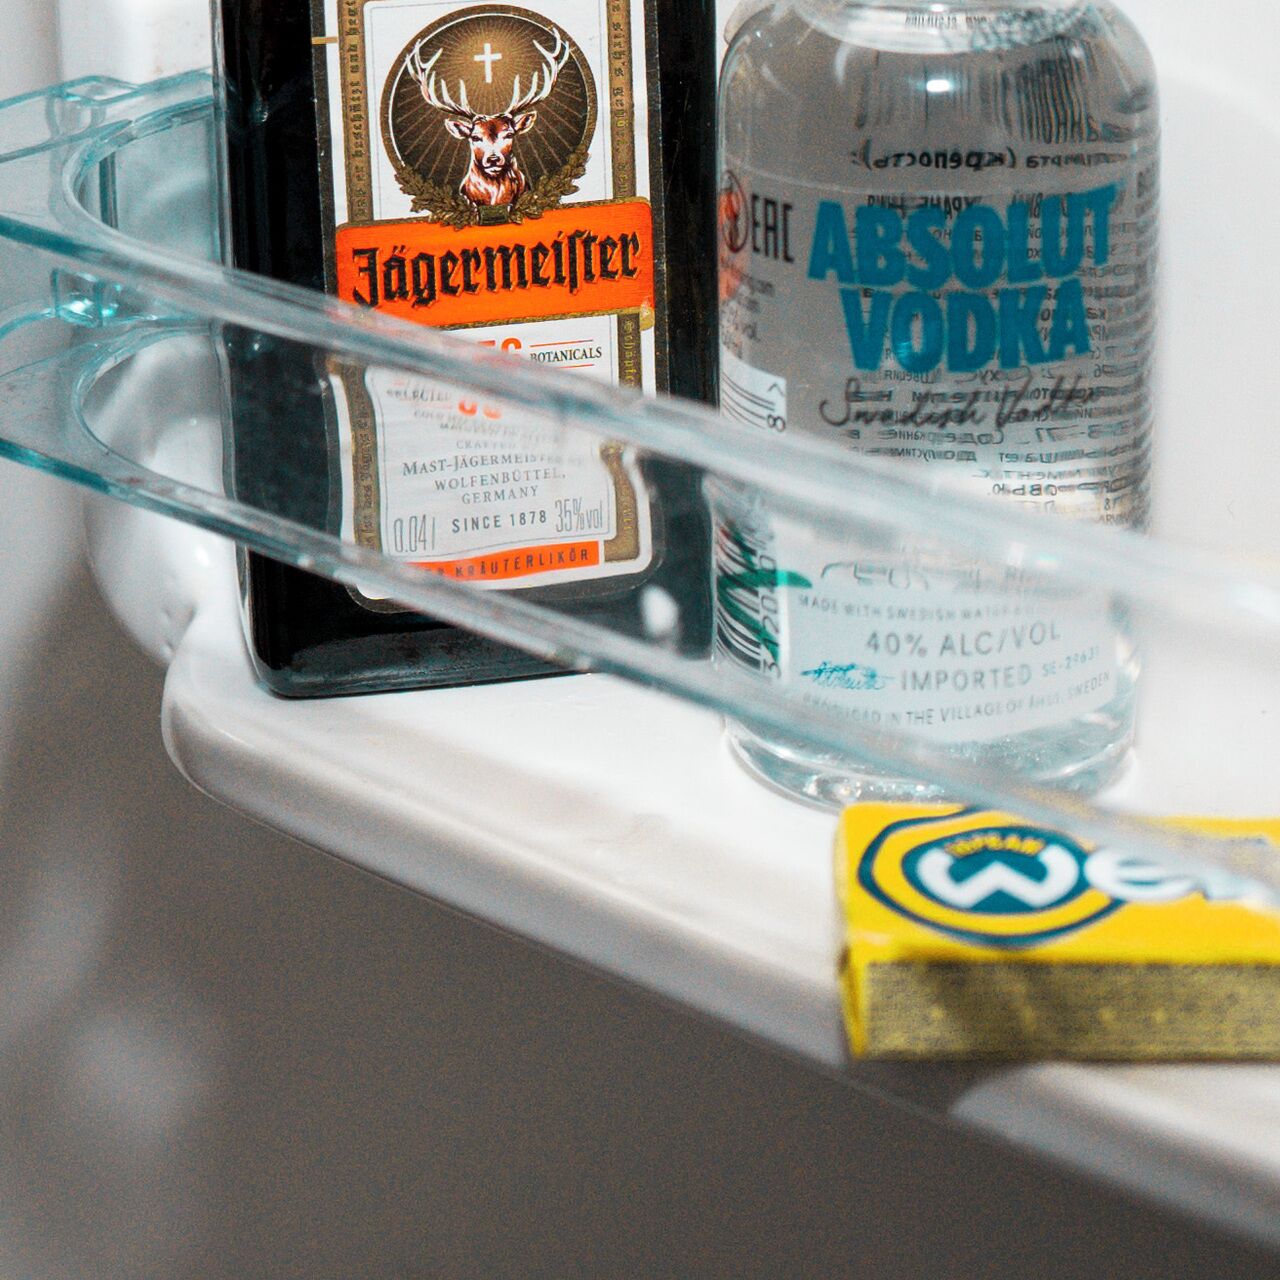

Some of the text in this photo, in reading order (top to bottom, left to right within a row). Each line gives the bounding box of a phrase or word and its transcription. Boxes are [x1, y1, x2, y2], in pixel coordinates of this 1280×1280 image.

[807, 178, 1126, 292] ABSOLUT
[351, 229, 641, 309] Jägermeister
[838, 276, 1093, 375] VODKA
[529, 346, 603, 364] BOTANICALS
[461, 485, 540, 506] GERMANY
[451, 514, 503, 534] SINCE
[510, 509, 548, 527] 1878
[867, 620, 1062, 658] 40% ALC/VOL
[900, 662, 1034, 693] IMPORTED
[906, 707, 935, 727] THE
[939, 700, 1004, 723] VILLAGE
